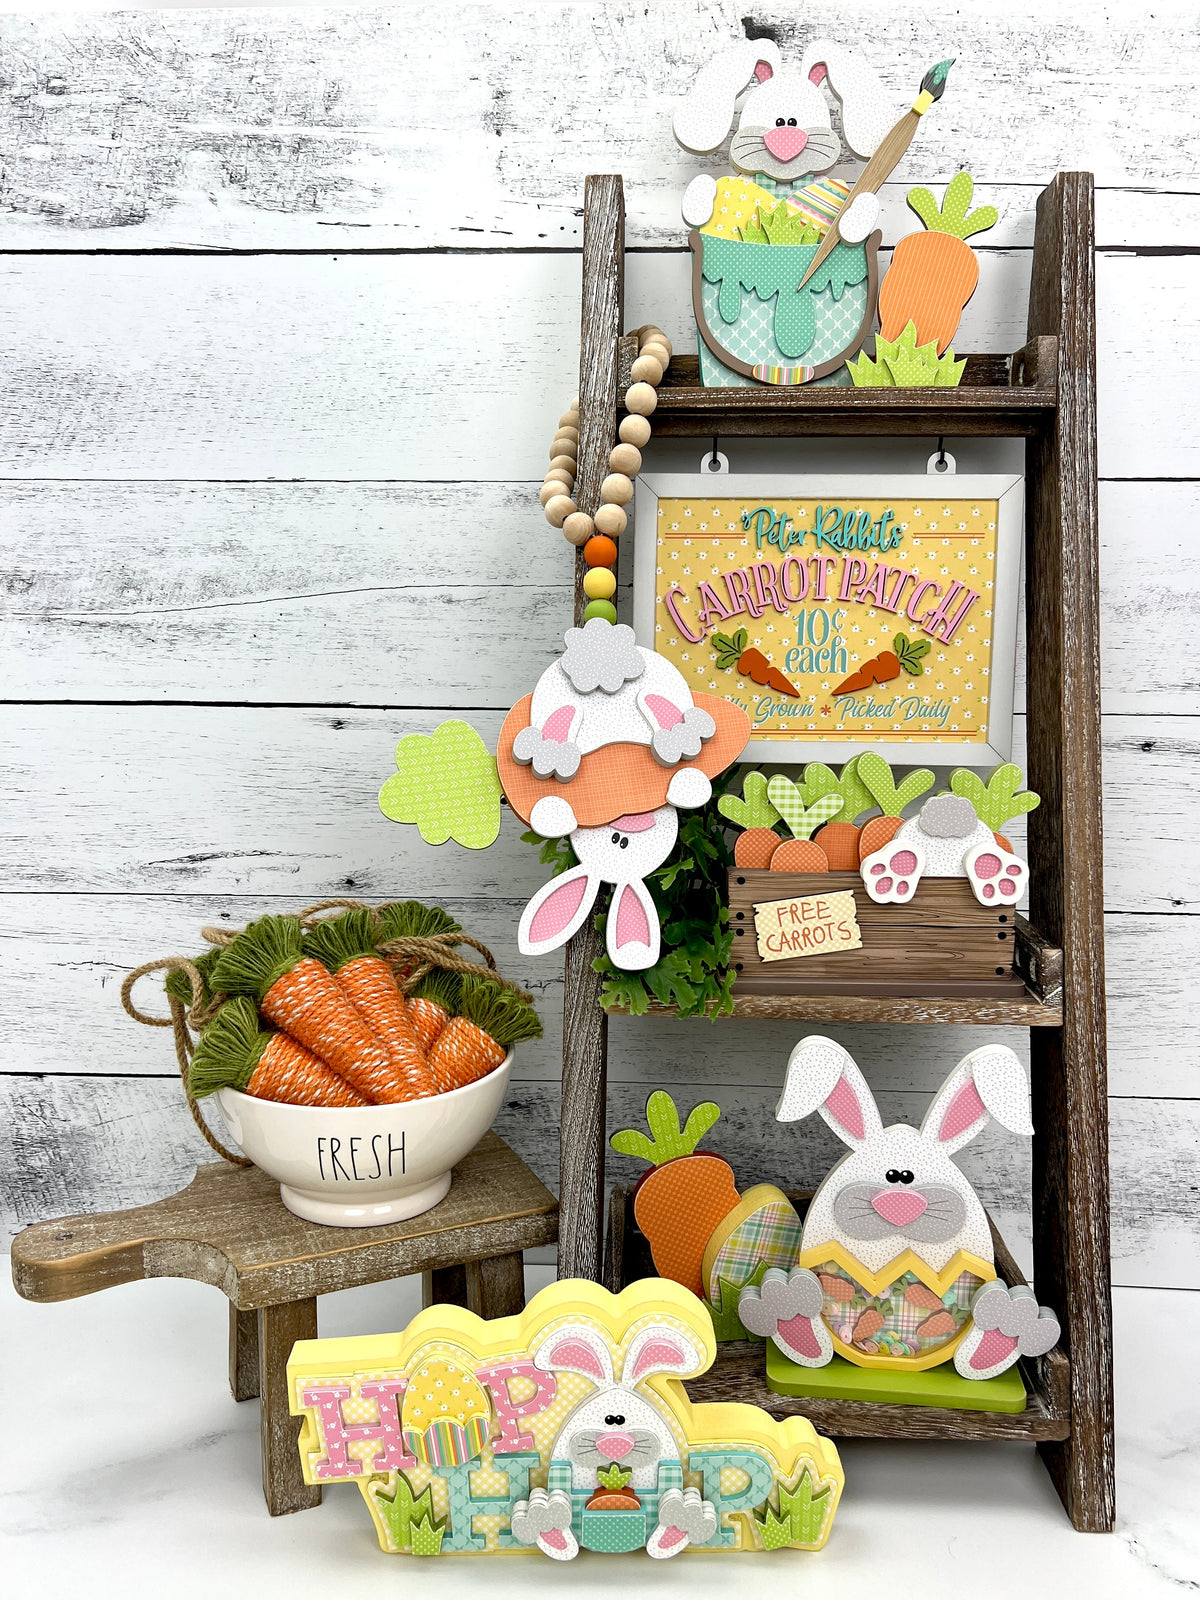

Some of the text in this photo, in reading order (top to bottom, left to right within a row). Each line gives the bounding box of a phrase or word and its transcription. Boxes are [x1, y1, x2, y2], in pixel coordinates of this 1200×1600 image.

[742, 506, 808, 552] Peter
[664, 556, 981, 645] CARROT PATCH
[785, 635, 848, 674] each
[754, 696, 815, 724] Grown
[834, 696, 897, 721] Picked
[898, 696, 951, 727] Daily
[777, 901, 832, 927] FREE
[766, 920, 852, 952] CARROTS
[317, 1131, 406, 1181] FRESH
